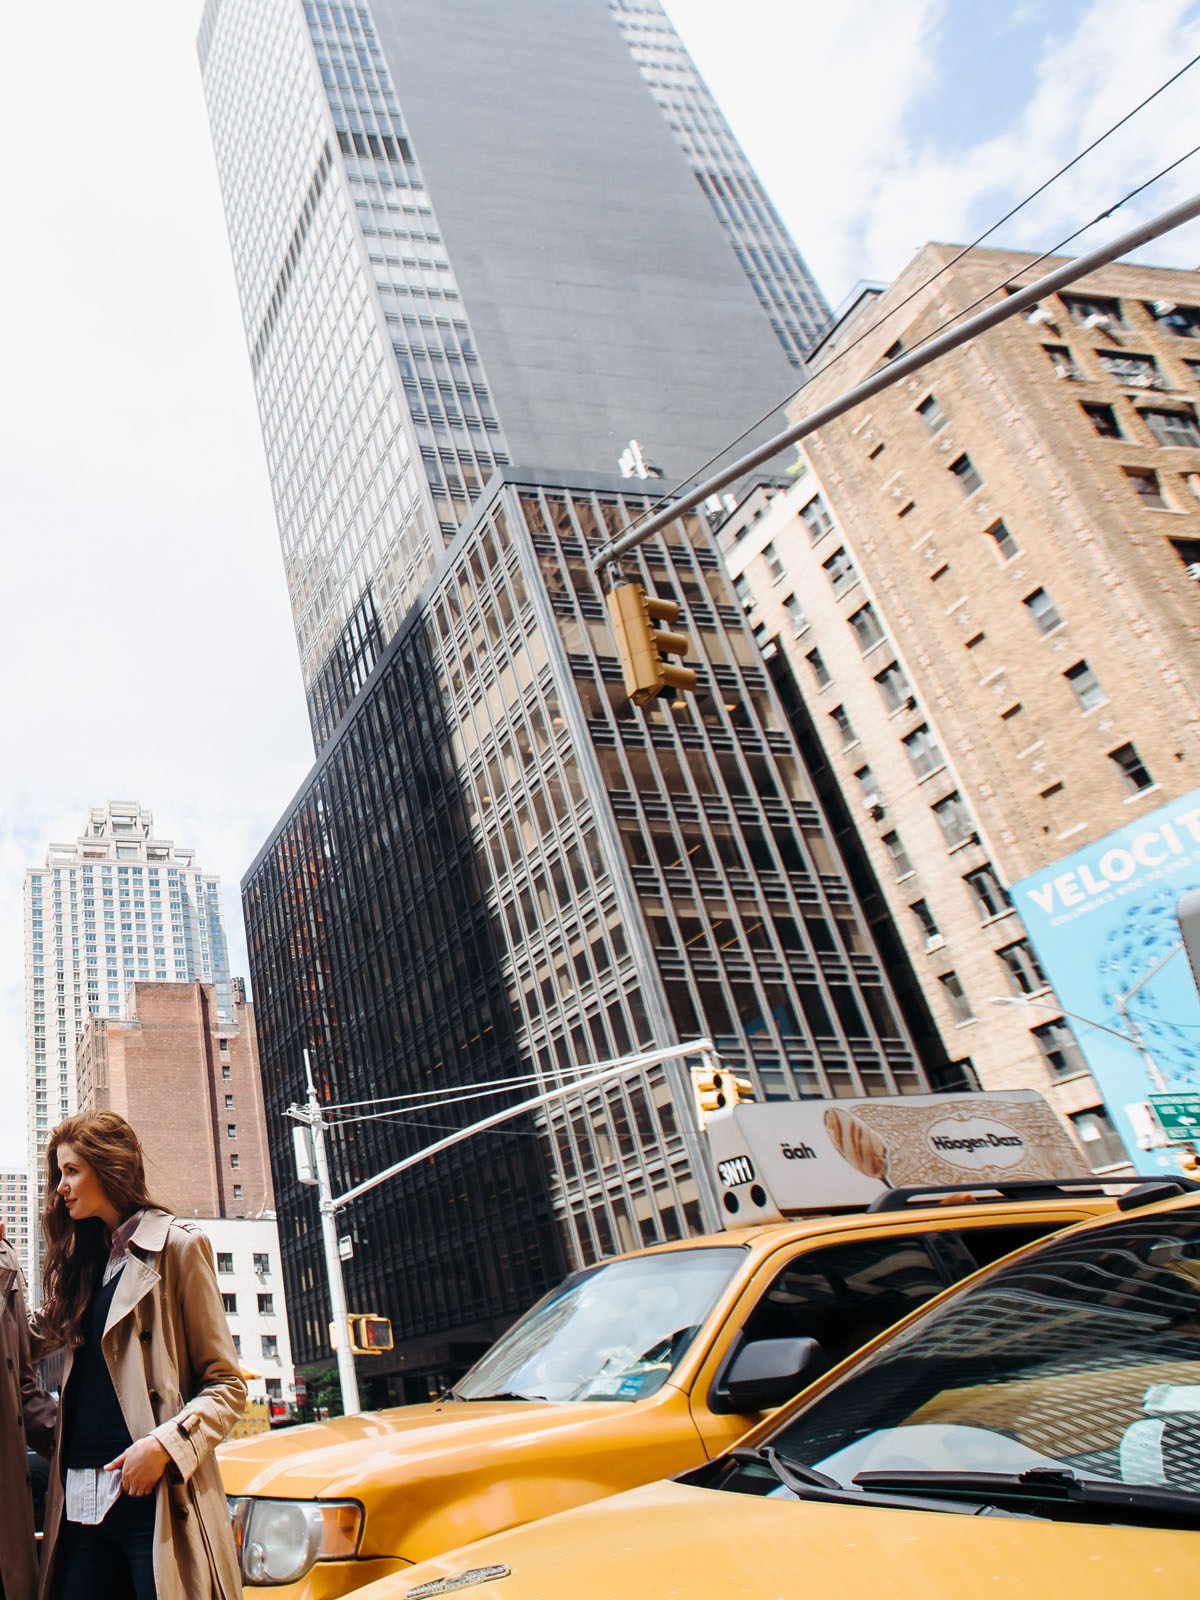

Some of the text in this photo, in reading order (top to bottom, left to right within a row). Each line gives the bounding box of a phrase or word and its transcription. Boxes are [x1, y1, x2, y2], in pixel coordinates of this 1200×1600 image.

[1026, 806, 1200, 914] VELOCIT
[781, 1143, 817, 1160] äah
[931, 1133, 1024, 1153] Häagen-Dazs
[720, 1157, 753, 1187] 3N11
